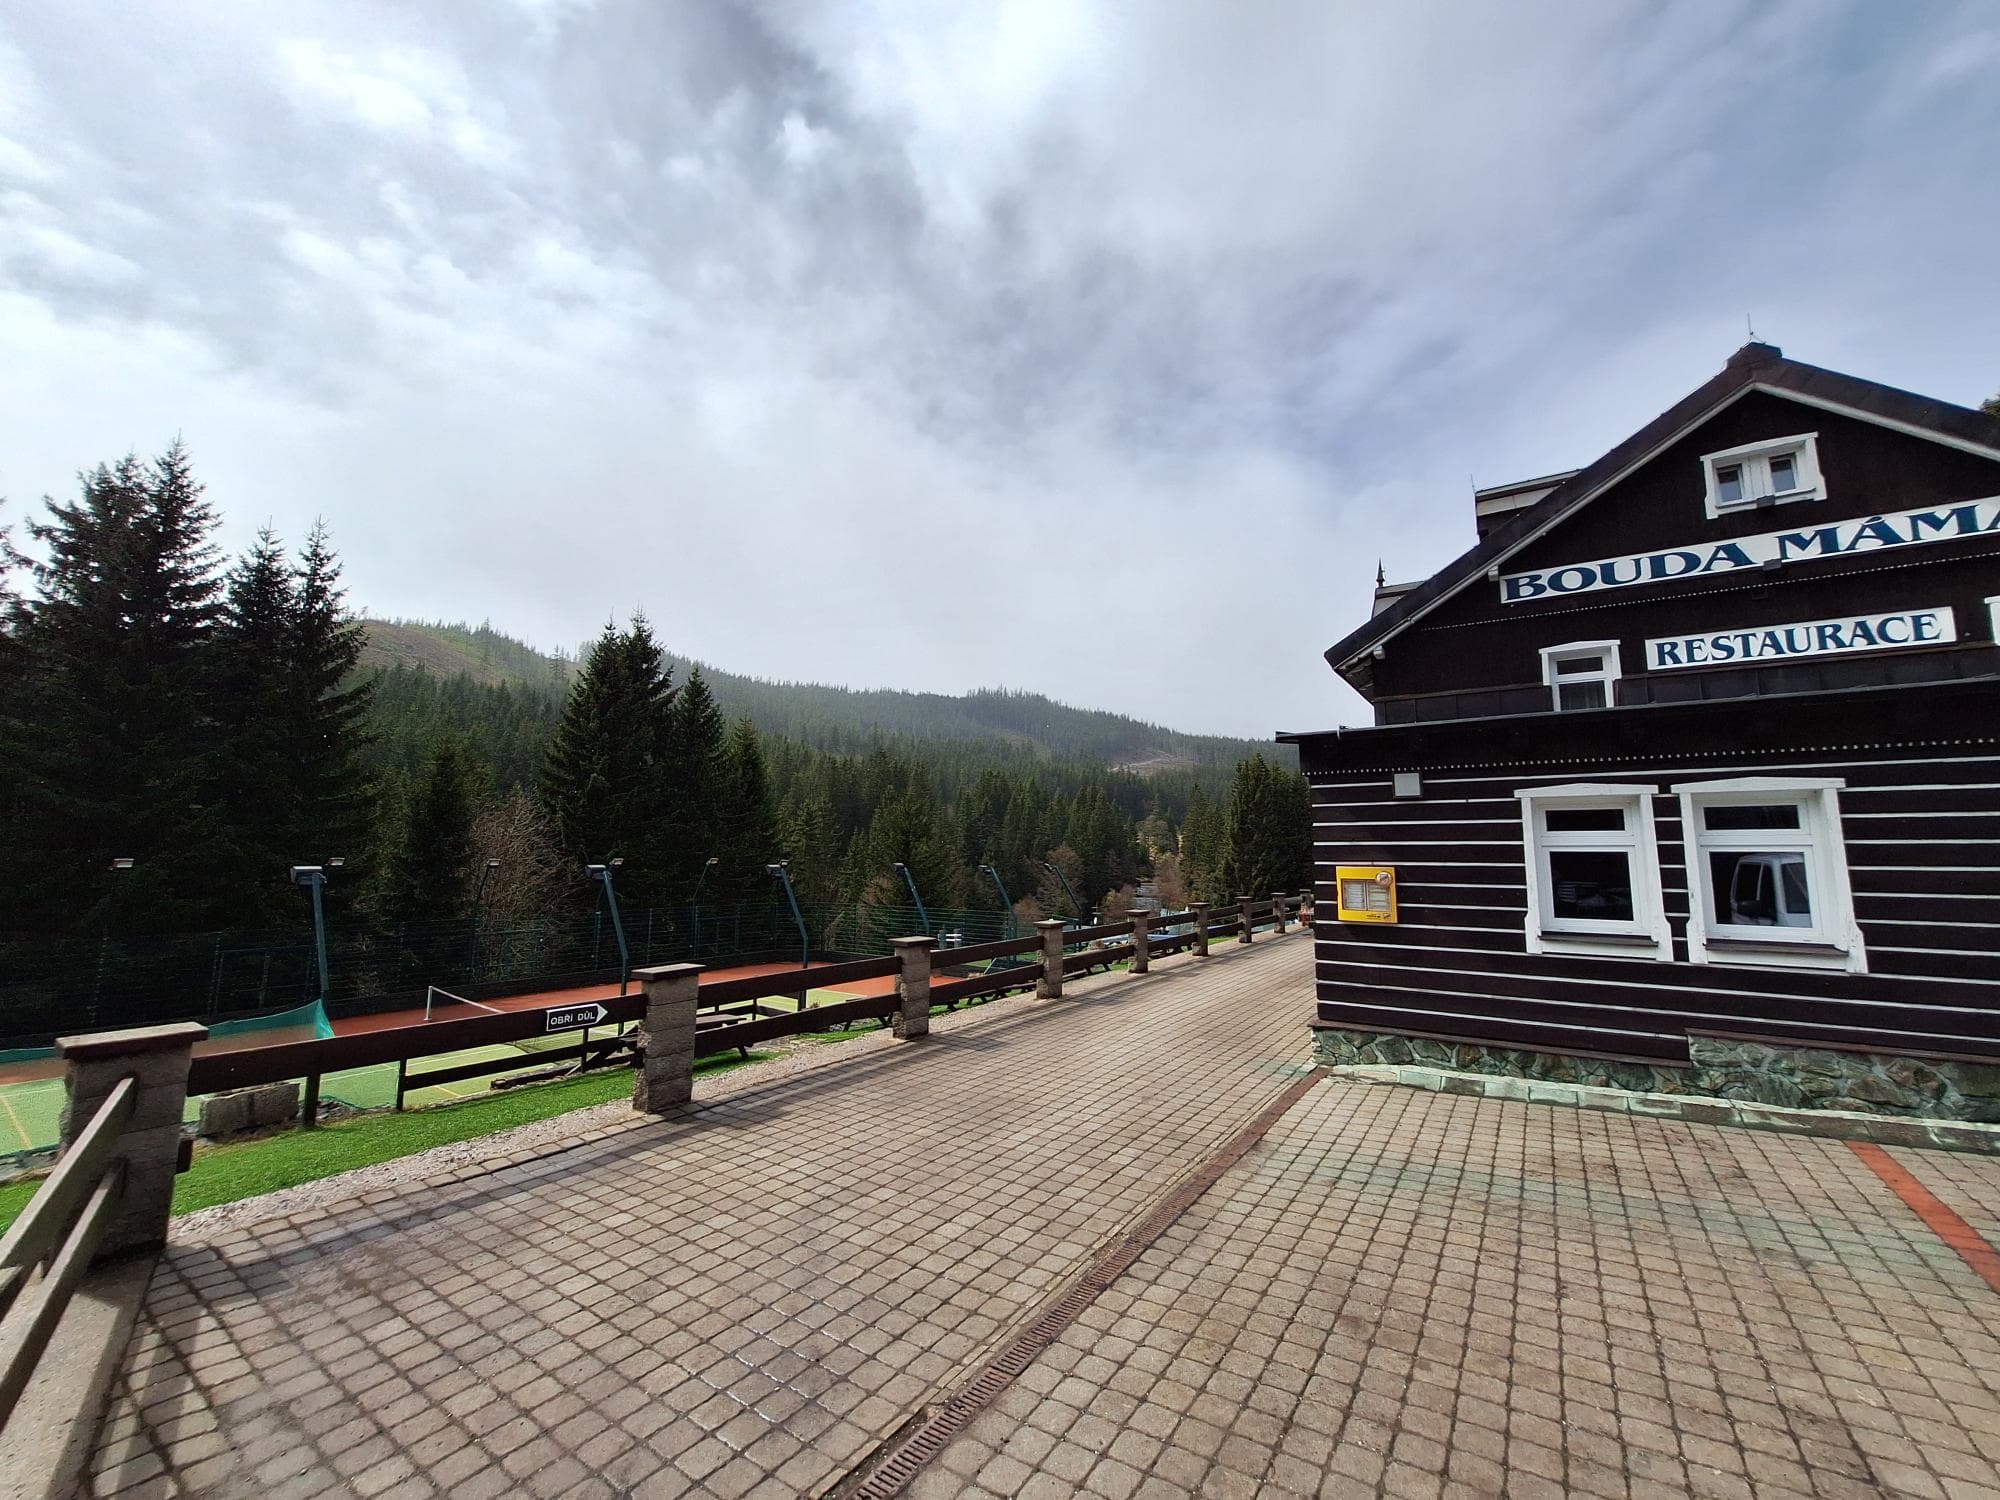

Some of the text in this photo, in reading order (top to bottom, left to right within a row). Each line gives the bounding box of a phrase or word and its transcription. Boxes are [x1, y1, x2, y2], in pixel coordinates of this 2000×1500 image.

[1502, 504, 2000, 600] BOUDA MÁM
[1655, 613, 1942, 666] RESTAURACE
[577, 1010, 595, 1021] DŮL
